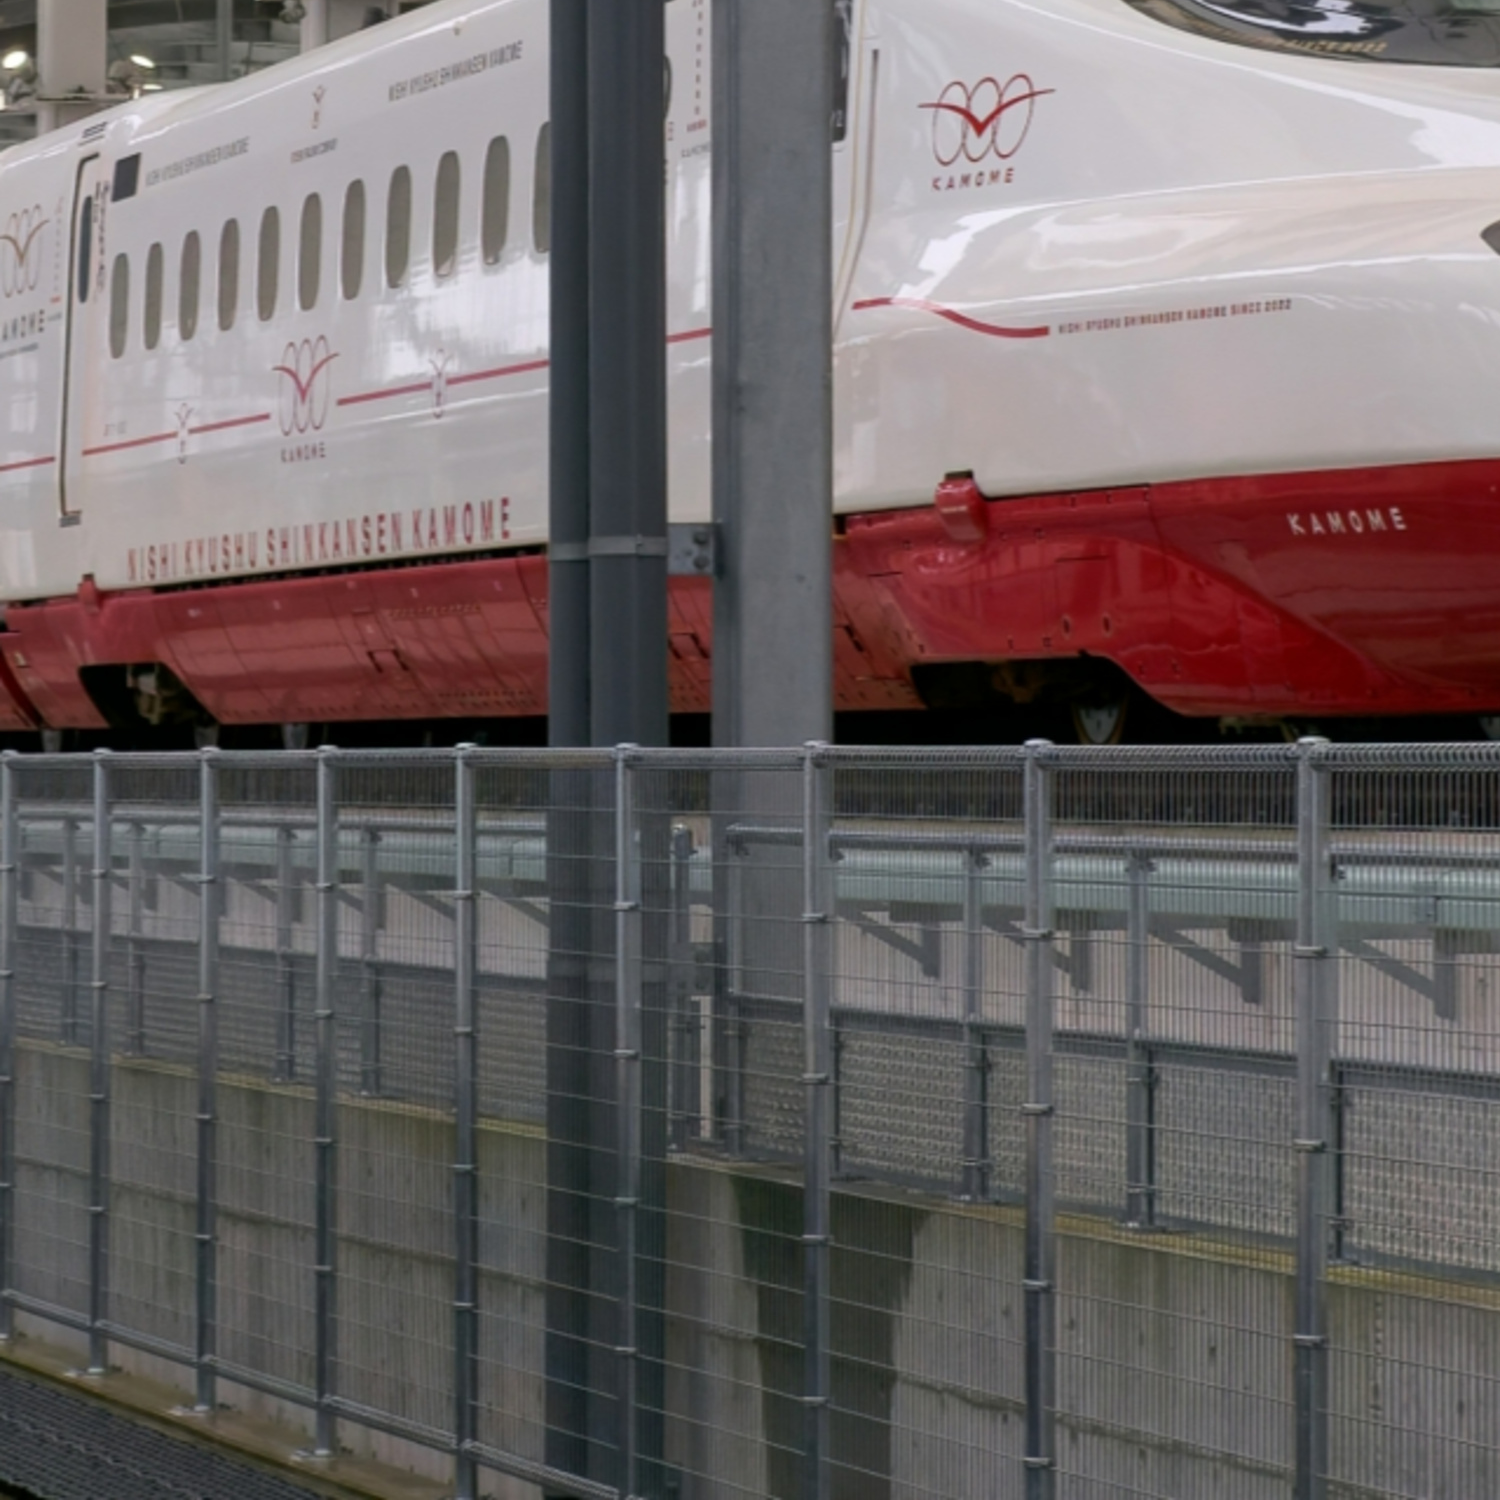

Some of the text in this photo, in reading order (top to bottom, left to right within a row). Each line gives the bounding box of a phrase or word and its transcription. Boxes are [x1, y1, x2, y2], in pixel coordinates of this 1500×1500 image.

[931, 166, 1015, 193] KAMOME
[1286, 504, 1408, 537] KAMOME
[127, 495, 511, 583] NISHI KYUSHU SHINKANSEN KAMOME
